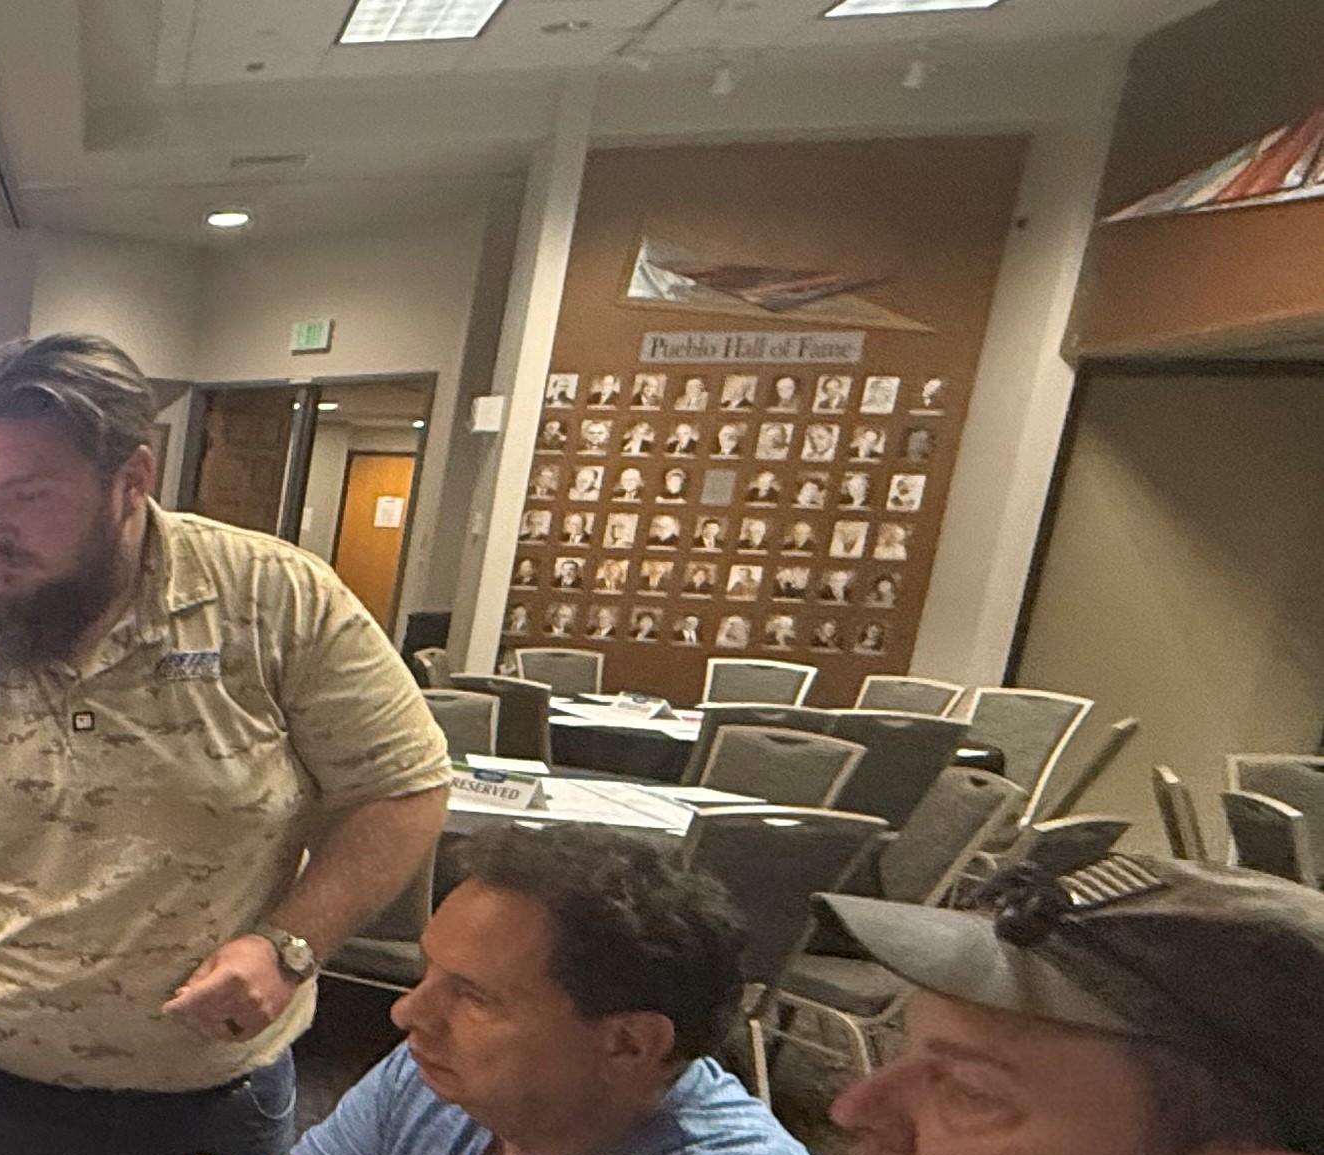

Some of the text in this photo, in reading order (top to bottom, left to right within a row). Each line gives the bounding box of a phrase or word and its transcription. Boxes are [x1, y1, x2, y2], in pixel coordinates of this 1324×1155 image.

[651, 336, 851, 358] Pueblo Hall of Fame
[451, 777, 520, 801] RESERVED
